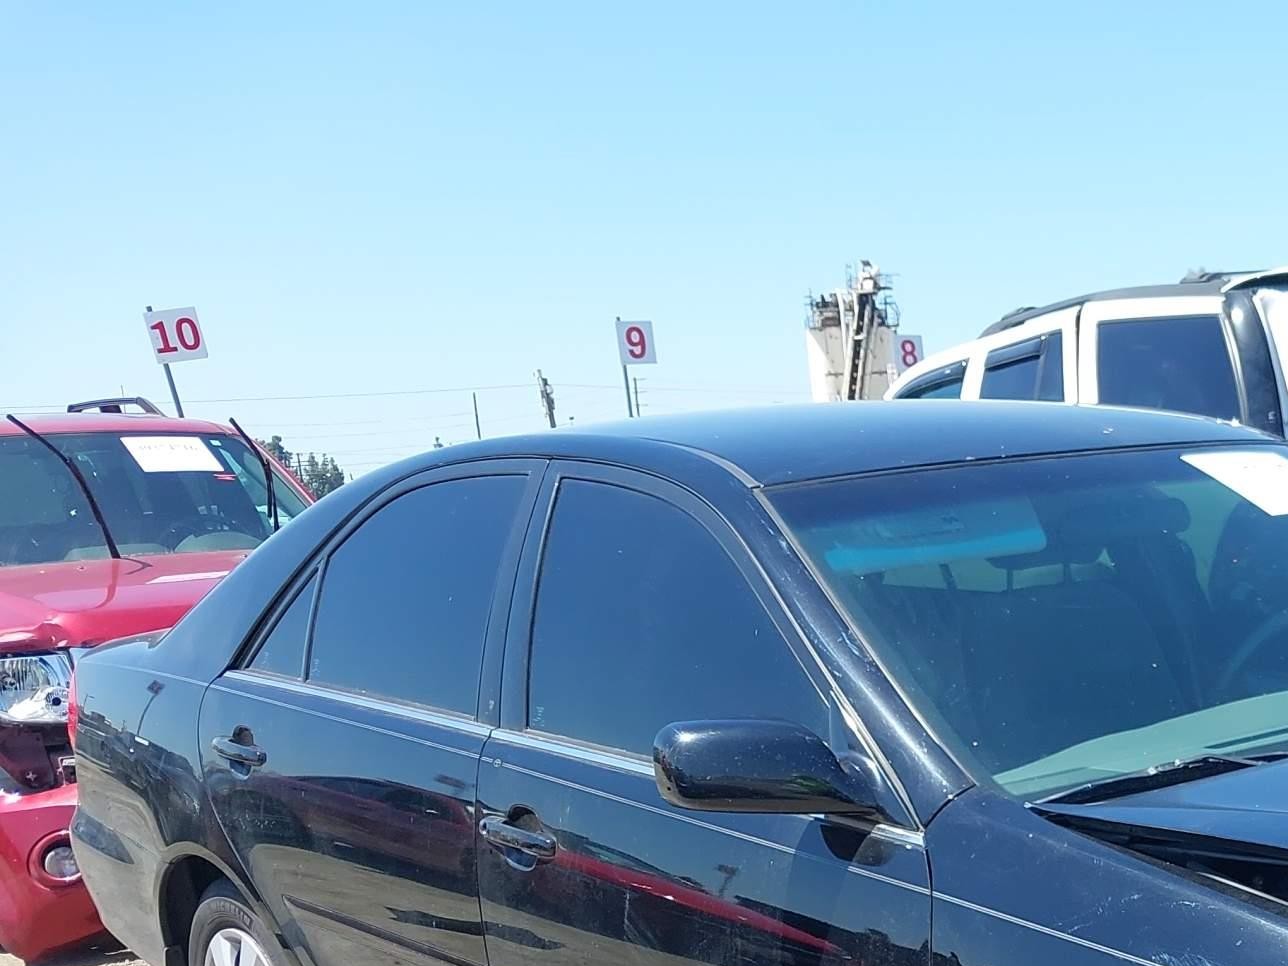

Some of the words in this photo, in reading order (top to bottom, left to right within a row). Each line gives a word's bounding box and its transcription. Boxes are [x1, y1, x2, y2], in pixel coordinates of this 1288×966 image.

[150, 317, 201, 354] 10
[625, 326, 646, 359] 9
[901, 340, 917, 367] 8
